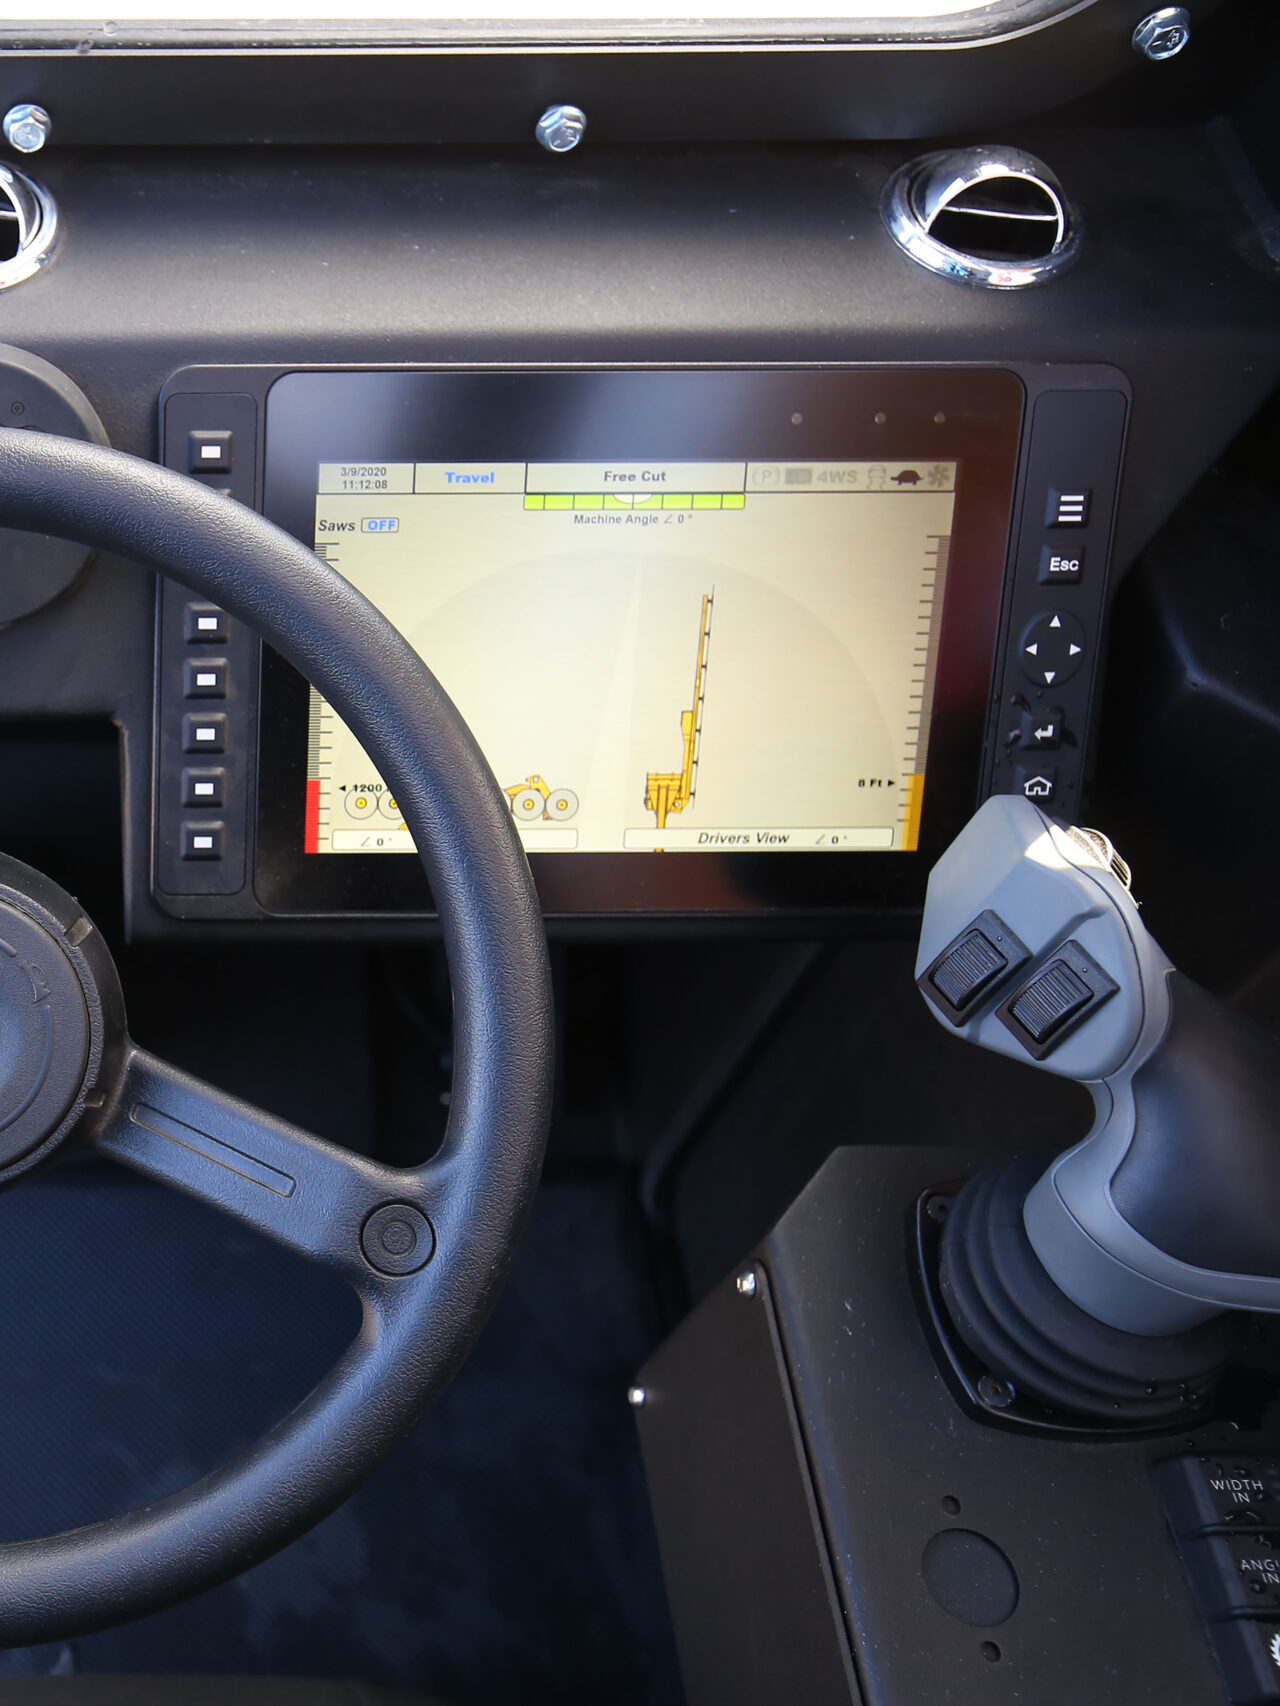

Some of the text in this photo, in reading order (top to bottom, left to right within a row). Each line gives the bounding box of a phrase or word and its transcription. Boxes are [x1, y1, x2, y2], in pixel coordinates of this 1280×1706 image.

[340, 466, 388, 477] 3/9/2020
[445, 471, 496, 484] Travel
[603, 470, 667, 483] Free Cut
[816, 469, 859, 484] 4WS
[342, 479, 389, 490] 11:12:08
[318, 519, 397, 532] Saws OFF
[573, 514, 623, 525] Machine
[625, 514, 660, 527] Angle
[1049, 556, 1080, 572] Esc
[351, 783, 383, 793] 1200
[869, 778, 883, 788] Ft
[697, 831, 751, 845] Drivers
[756, 831, 791, 845] View
[1209, 1479, 1264, 1491] WIDTH
[1231, 1491, 1250, 1503] IN
